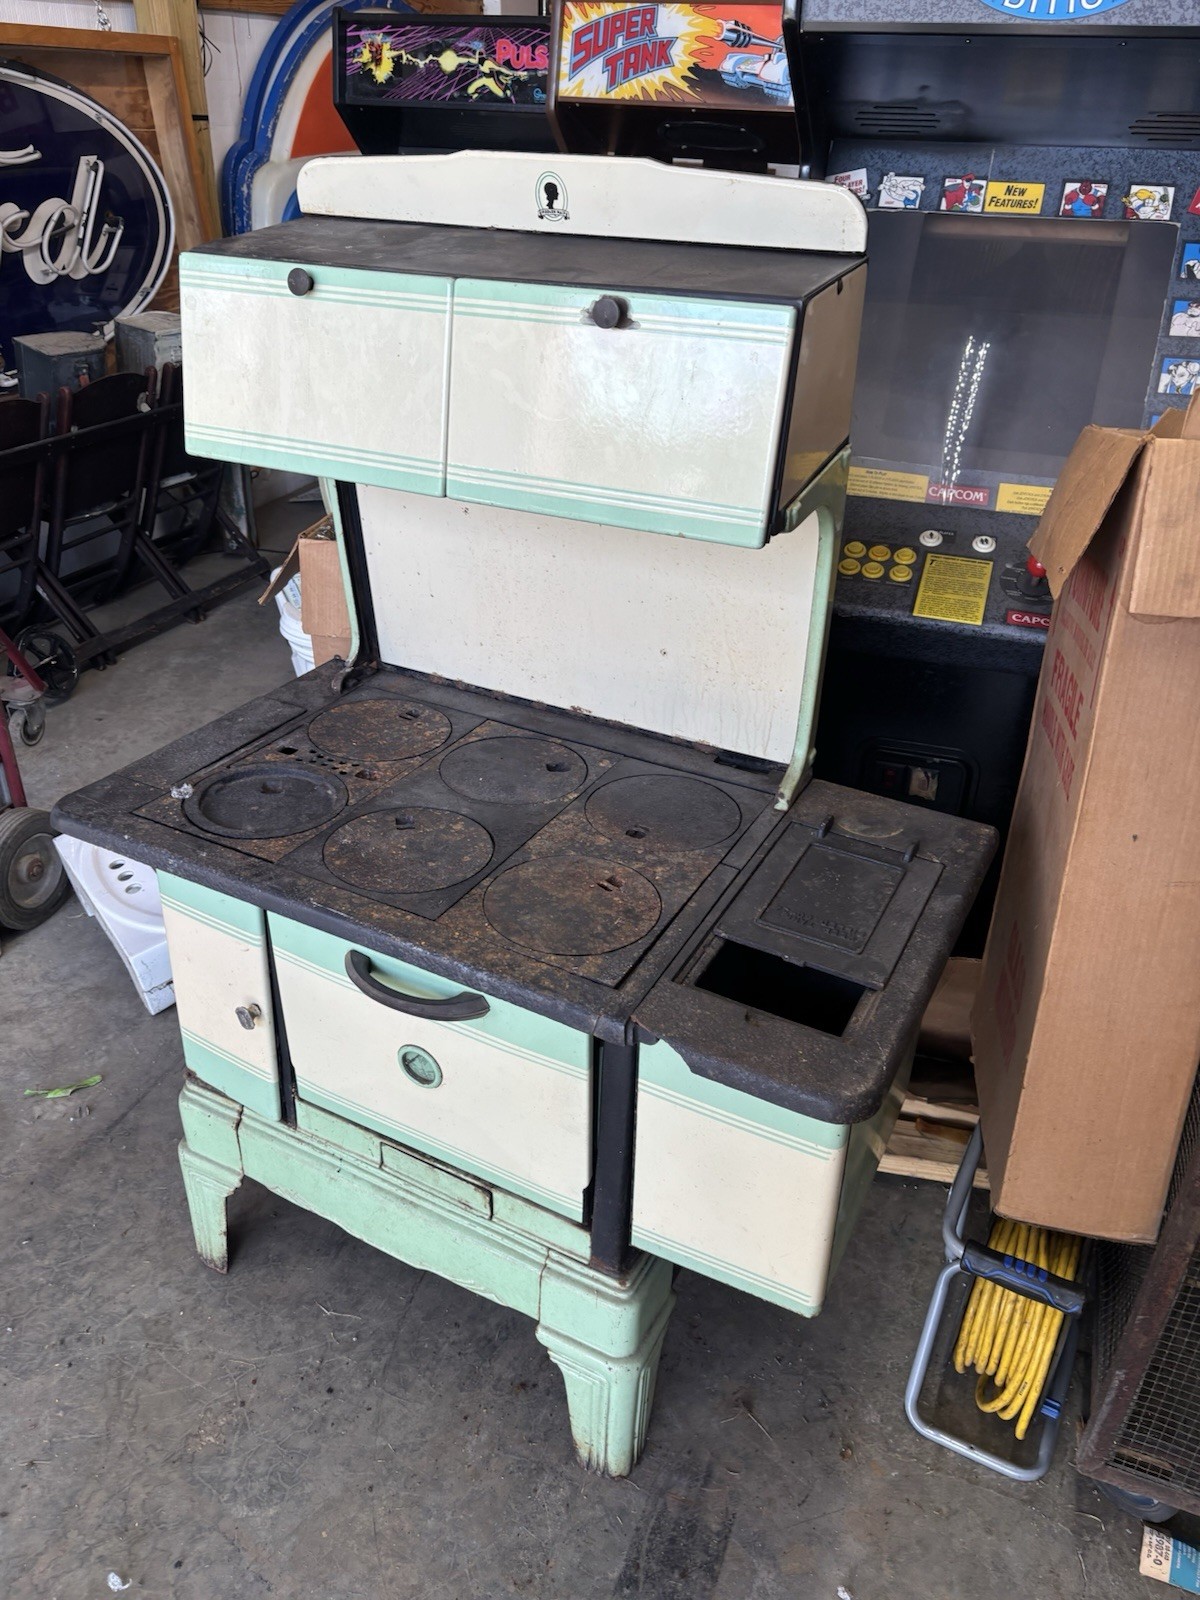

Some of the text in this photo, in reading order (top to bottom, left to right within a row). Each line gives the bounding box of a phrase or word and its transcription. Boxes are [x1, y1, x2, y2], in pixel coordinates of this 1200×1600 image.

[496, 38, 548, 69] PULS
[570, 5, 657, 79] SUPER
[603, 38, 677, 92] TANK
[988, 196, 1039, 209] FEATURES!
[928, 486, 984, 502] CAPCOM
[1011, 613, 1050, 627] CAPC
[1051, 648, 1084, 742] FRAGILE
